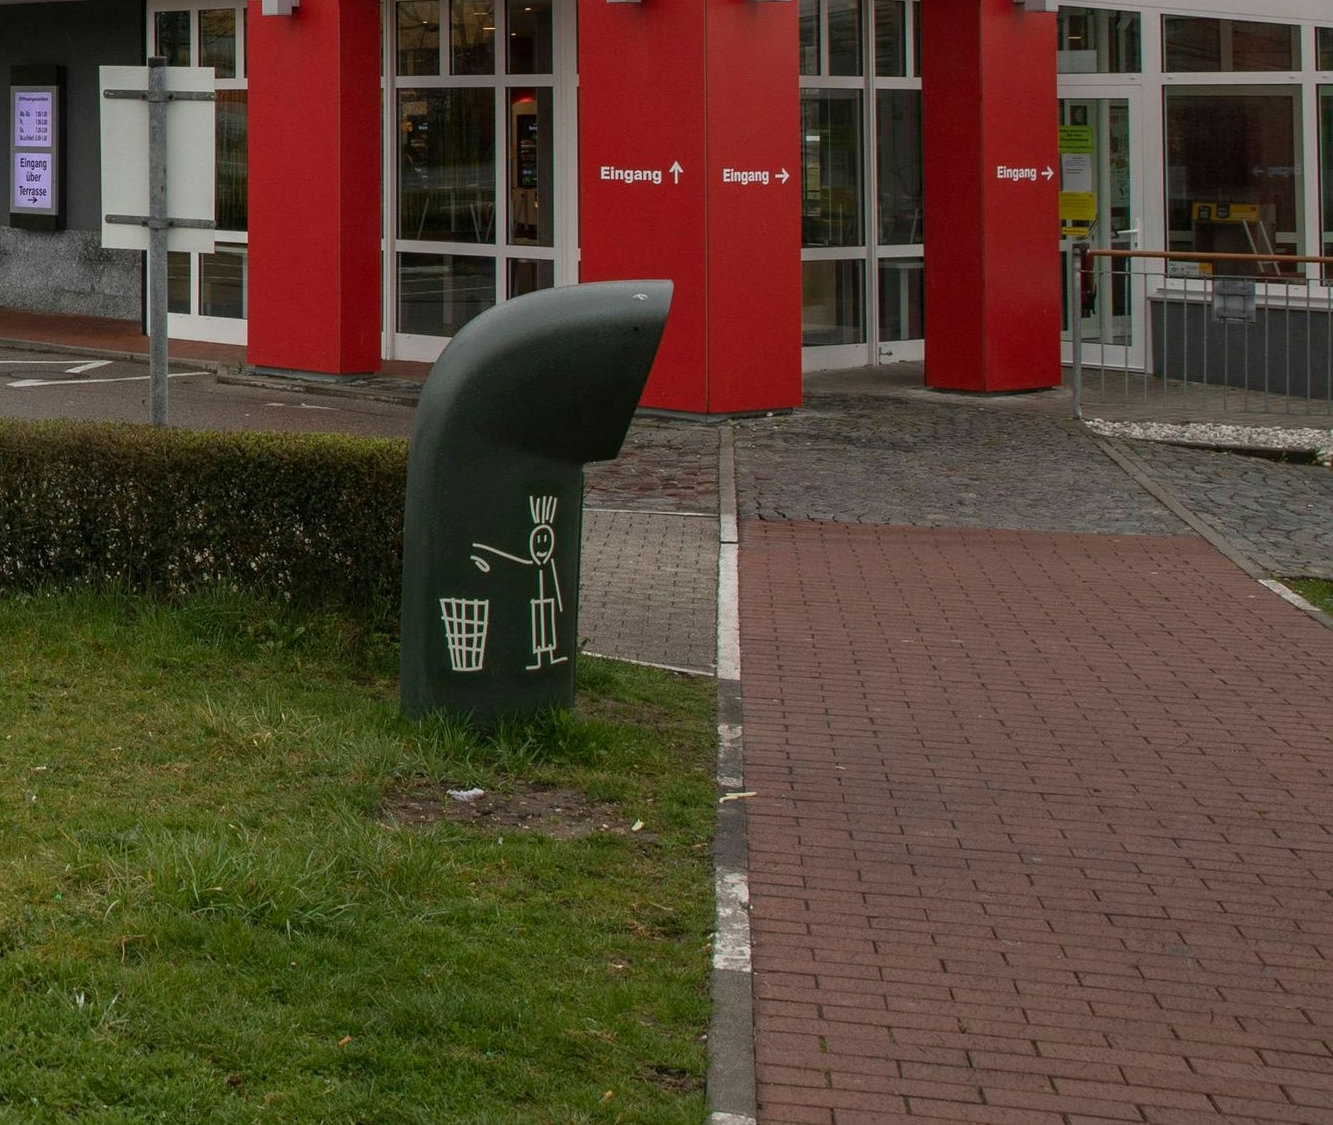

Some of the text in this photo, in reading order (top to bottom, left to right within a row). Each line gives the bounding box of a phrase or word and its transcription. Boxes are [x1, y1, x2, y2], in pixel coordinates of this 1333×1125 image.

[20, 157, 47, 171] Eingang
[26, 171, 41, 182] über
[600, 166, 662, 184] Eingang
[722, 168, 769, 185] Eingang
[996, 165, 1037, 182] Eingang
[19, 185, 47, 196] Terrasse
